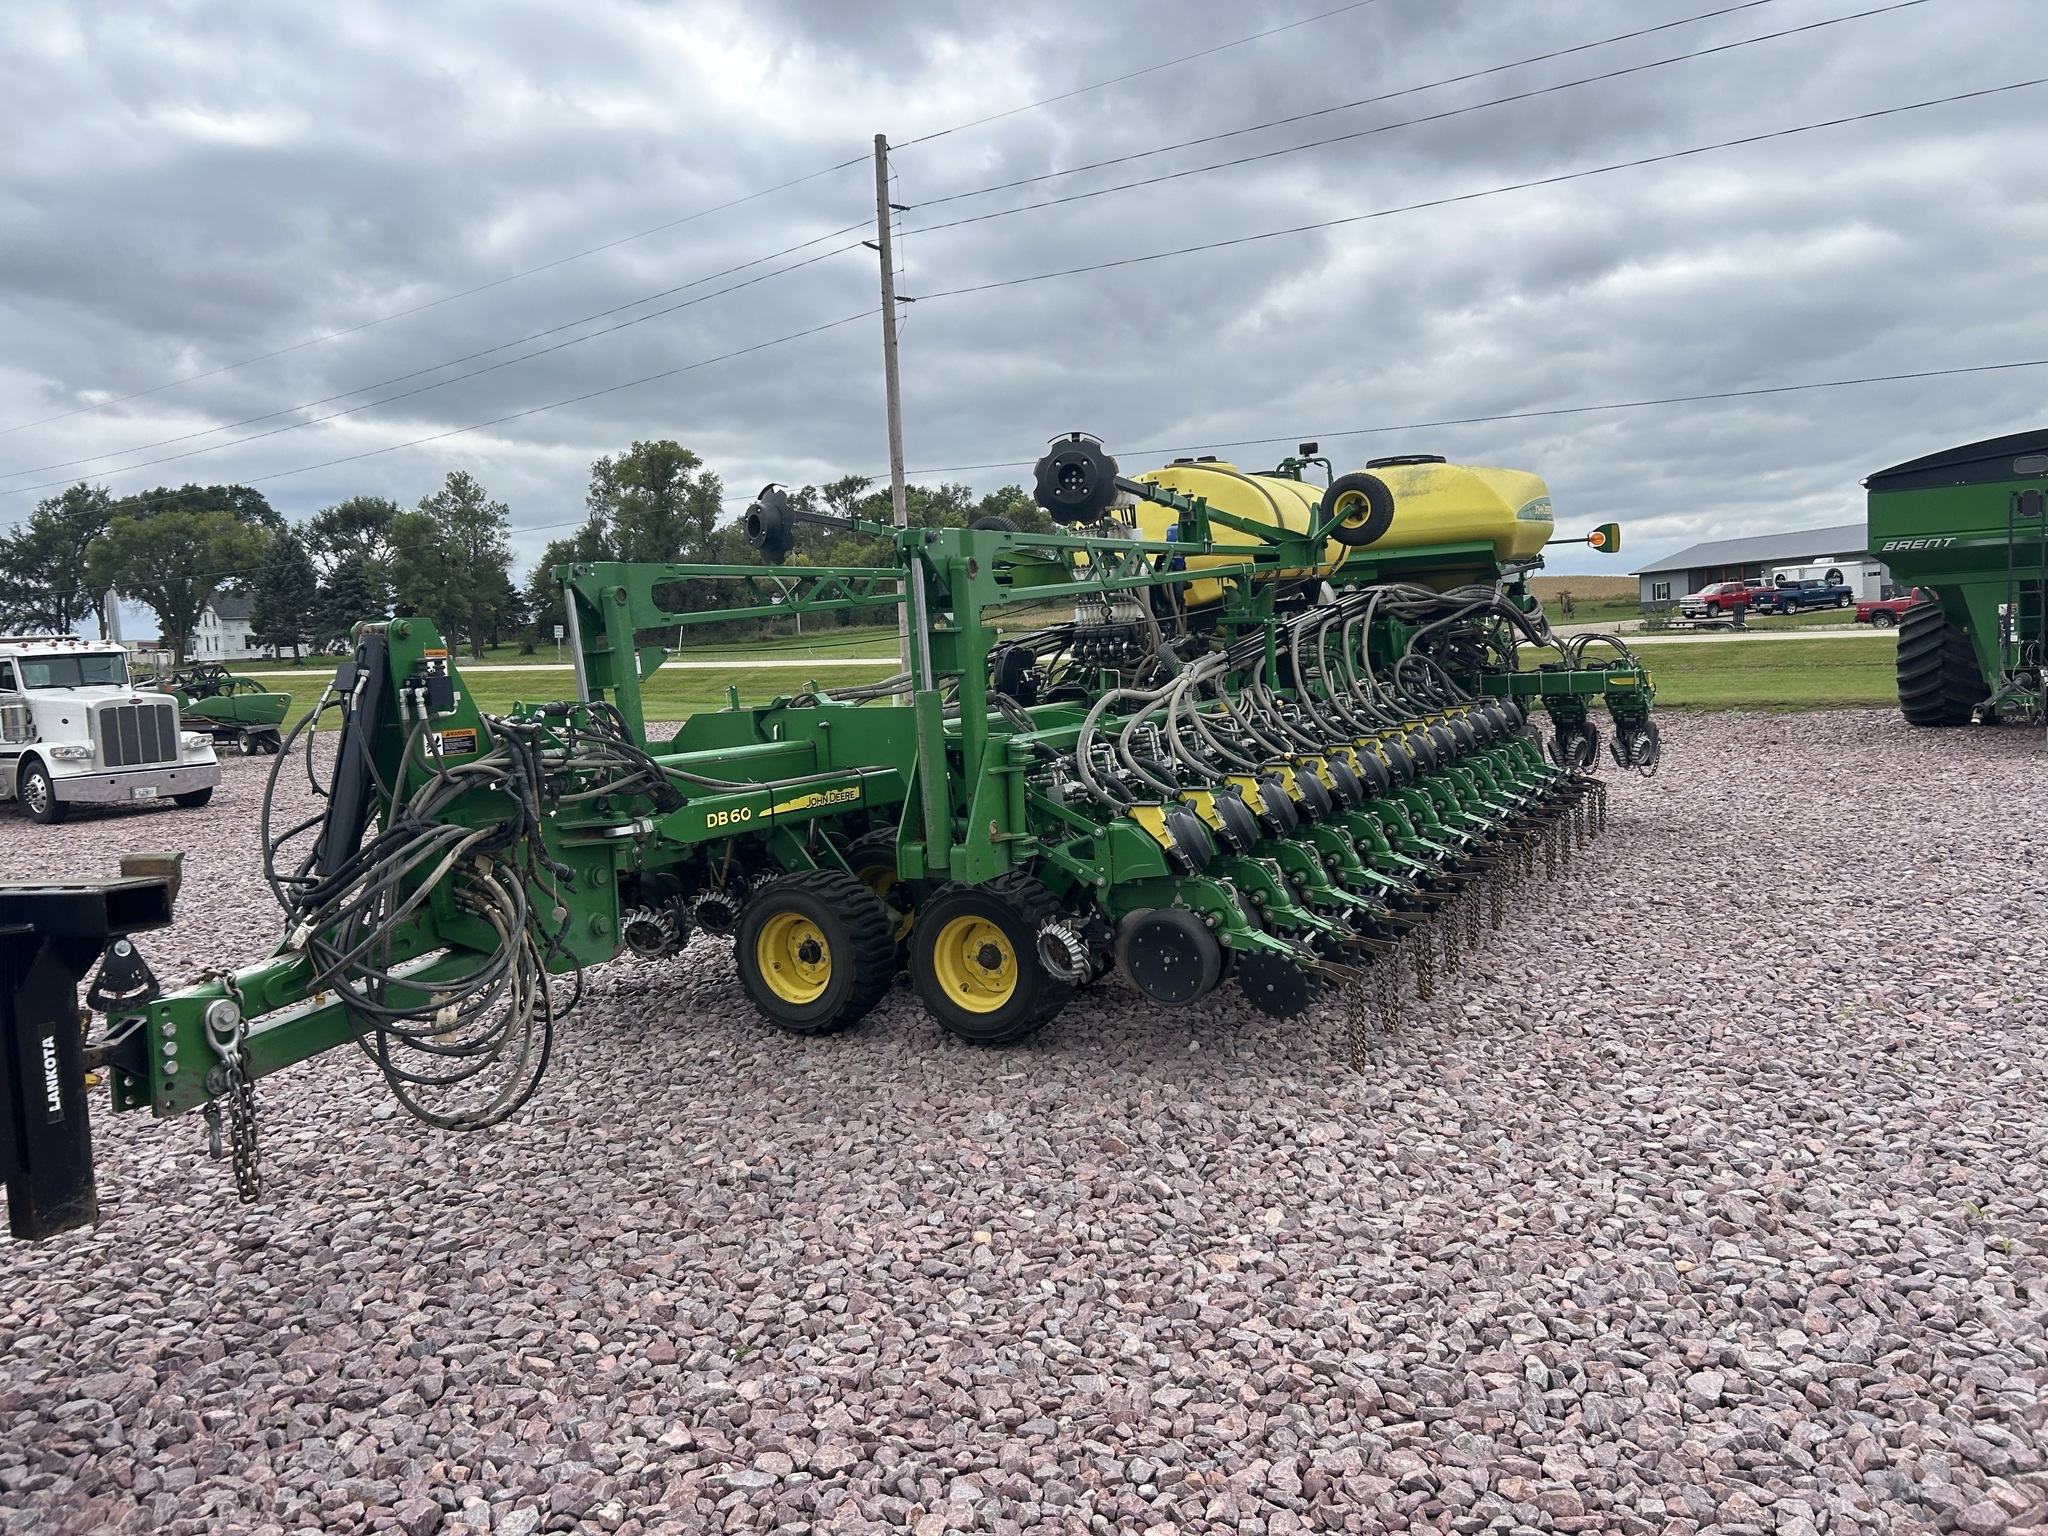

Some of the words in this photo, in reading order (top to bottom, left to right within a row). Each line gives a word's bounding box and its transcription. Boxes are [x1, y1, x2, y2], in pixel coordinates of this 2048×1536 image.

[1881, 537, 1957, 552] BRENT
[806, 794, 829, 809] JOHN
[829, 789, 856, 806] DEERE
[706, 812, 729, 829] DB
[730, 806, 752, 823] 60
[41, 1035, 61, 1113] LANKOTA
